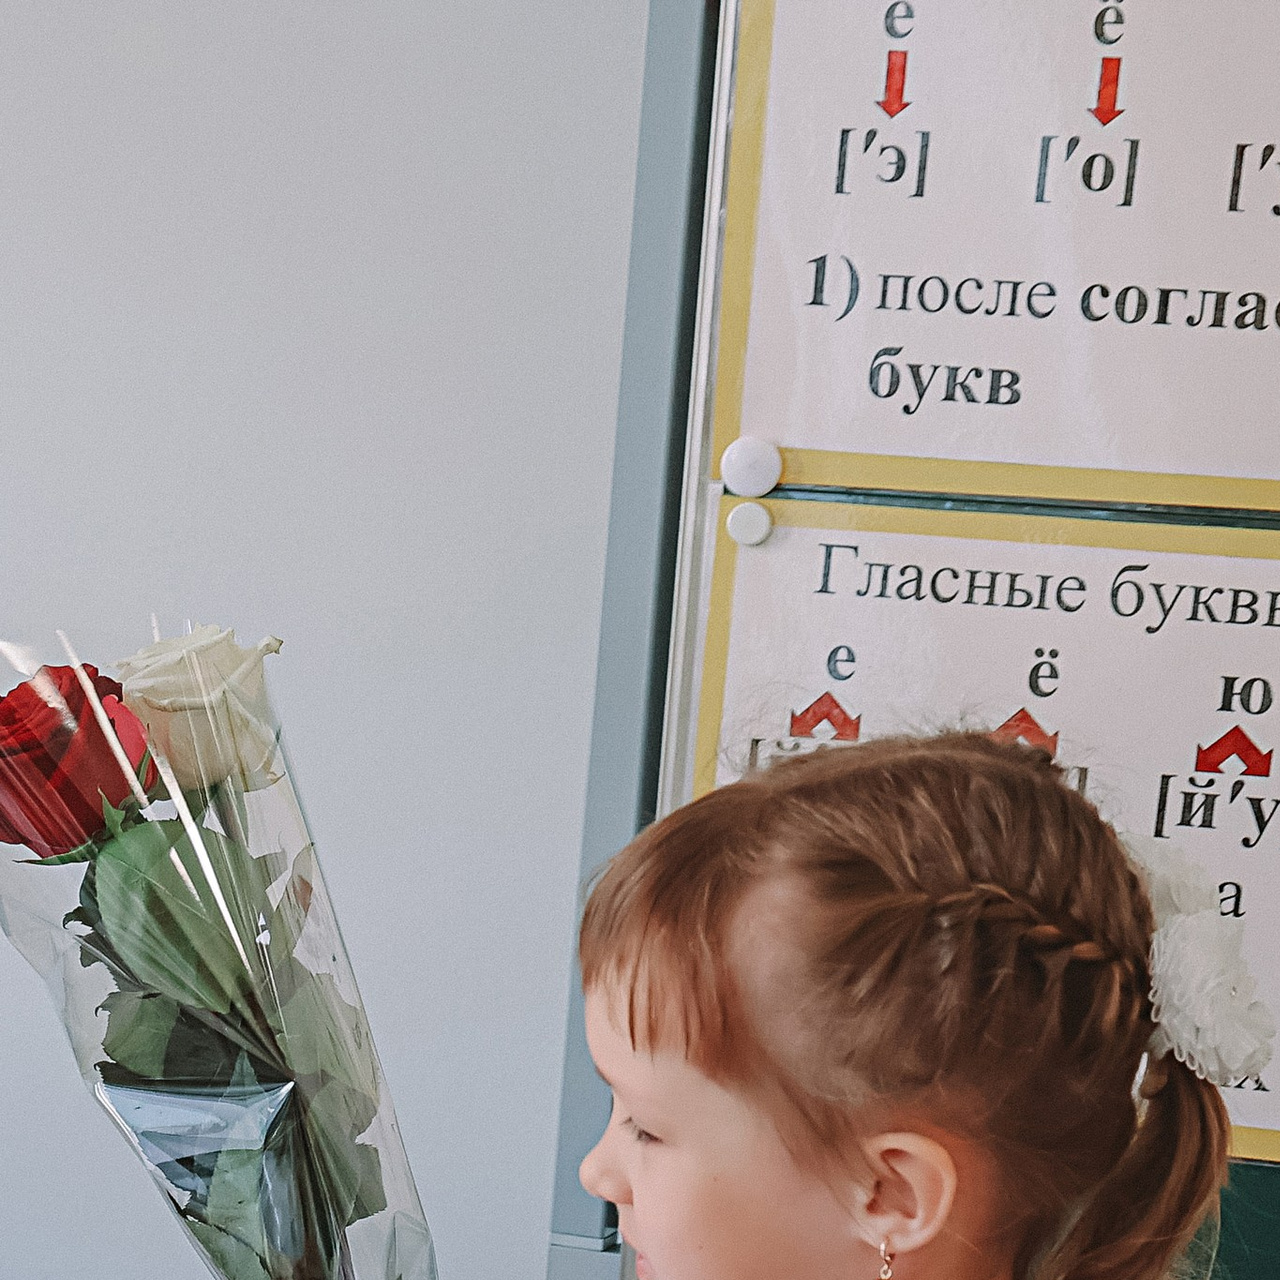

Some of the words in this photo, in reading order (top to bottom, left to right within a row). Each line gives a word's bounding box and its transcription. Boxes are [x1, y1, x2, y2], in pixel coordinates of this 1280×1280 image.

[884, 0, 915, 39] е
[806, 254, 860, 322] 1)
[875, 273, 1057, 319] после
[1080, 283, 1280, 331] согла
[868, 346, 1022, 416] букв
[814, 543, 1087, 613] Гласные
[826, 645, 856, 681] е
[1028, 648, 1060, 698] ё
[1216, 676, 1273, 716] ю
